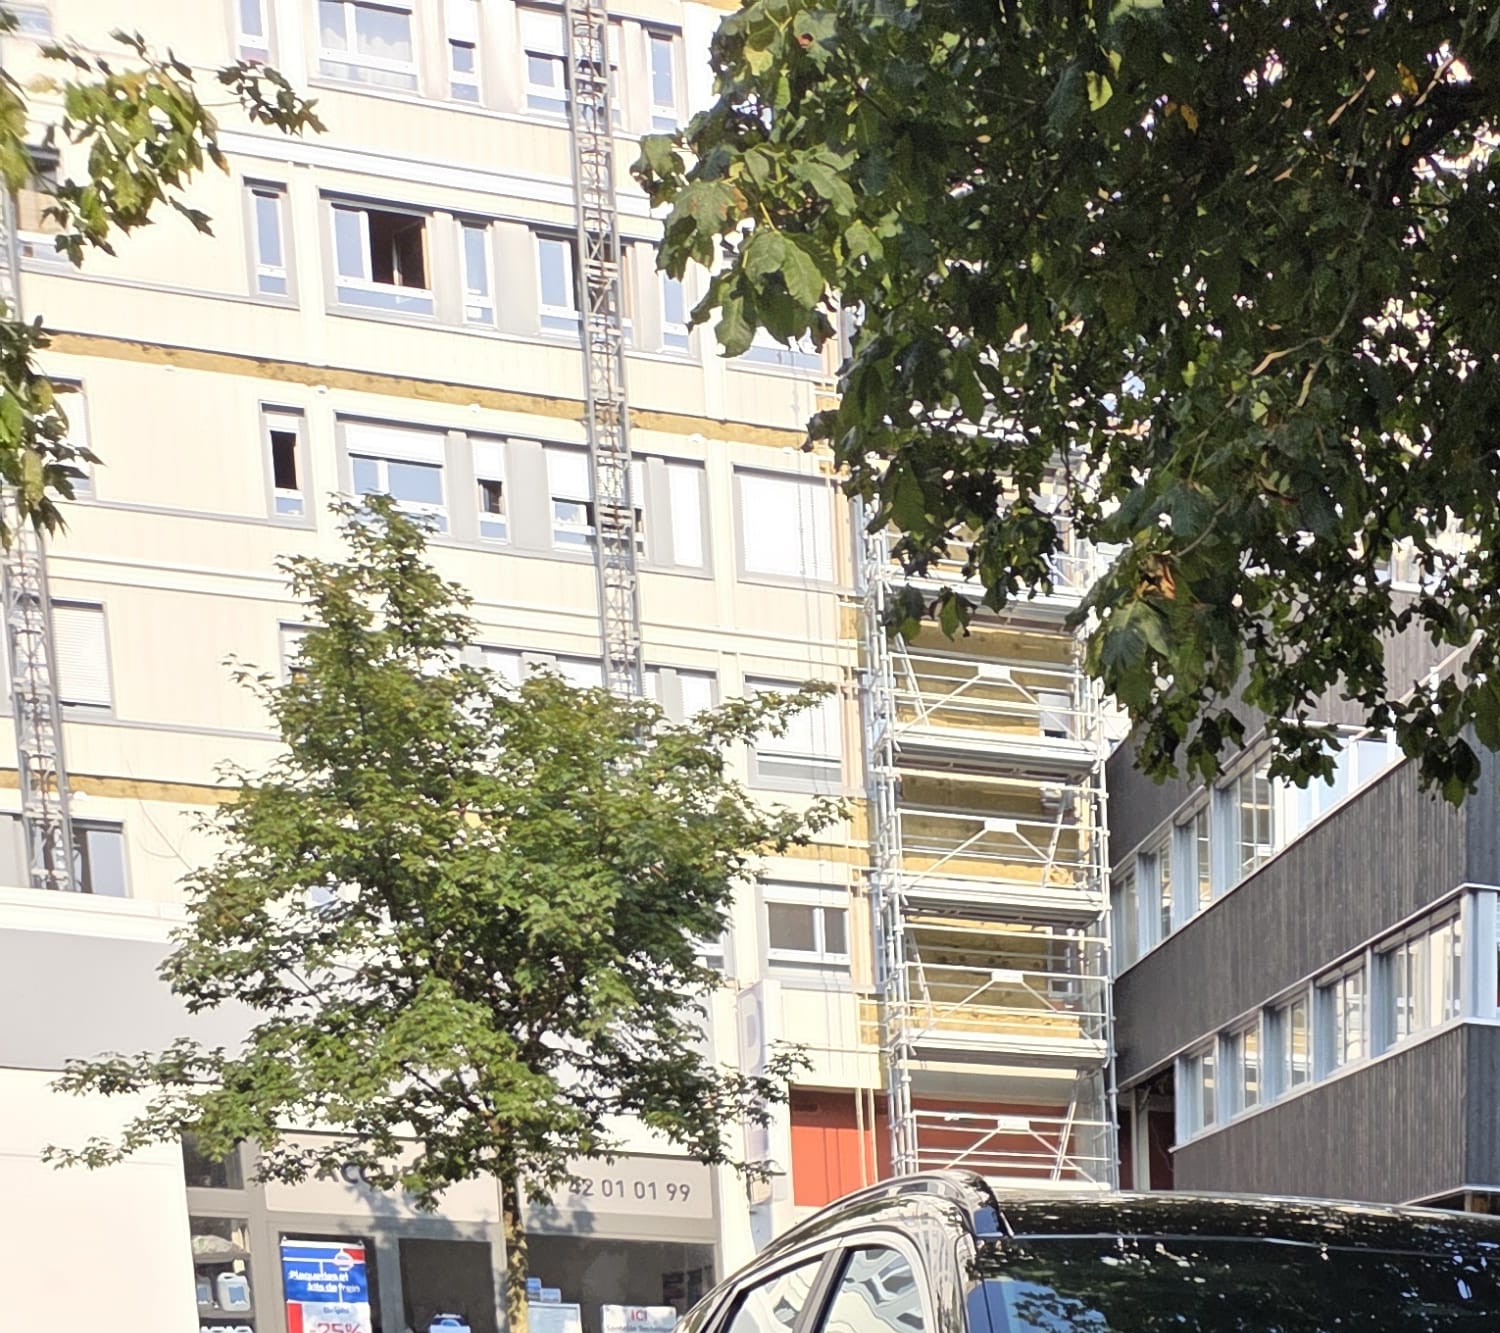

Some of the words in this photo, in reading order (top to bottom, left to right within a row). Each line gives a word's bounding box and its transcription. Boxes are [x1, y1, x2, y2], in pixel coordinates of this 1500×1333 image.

[568, 1179, 594, 1197] 42
[601, 1179, 625, 1198] 01
[634, 1181, 657, 1200] 01
[666, 1183, 691, 1202] 99
[630, 1310, 648, 1321] ICI
